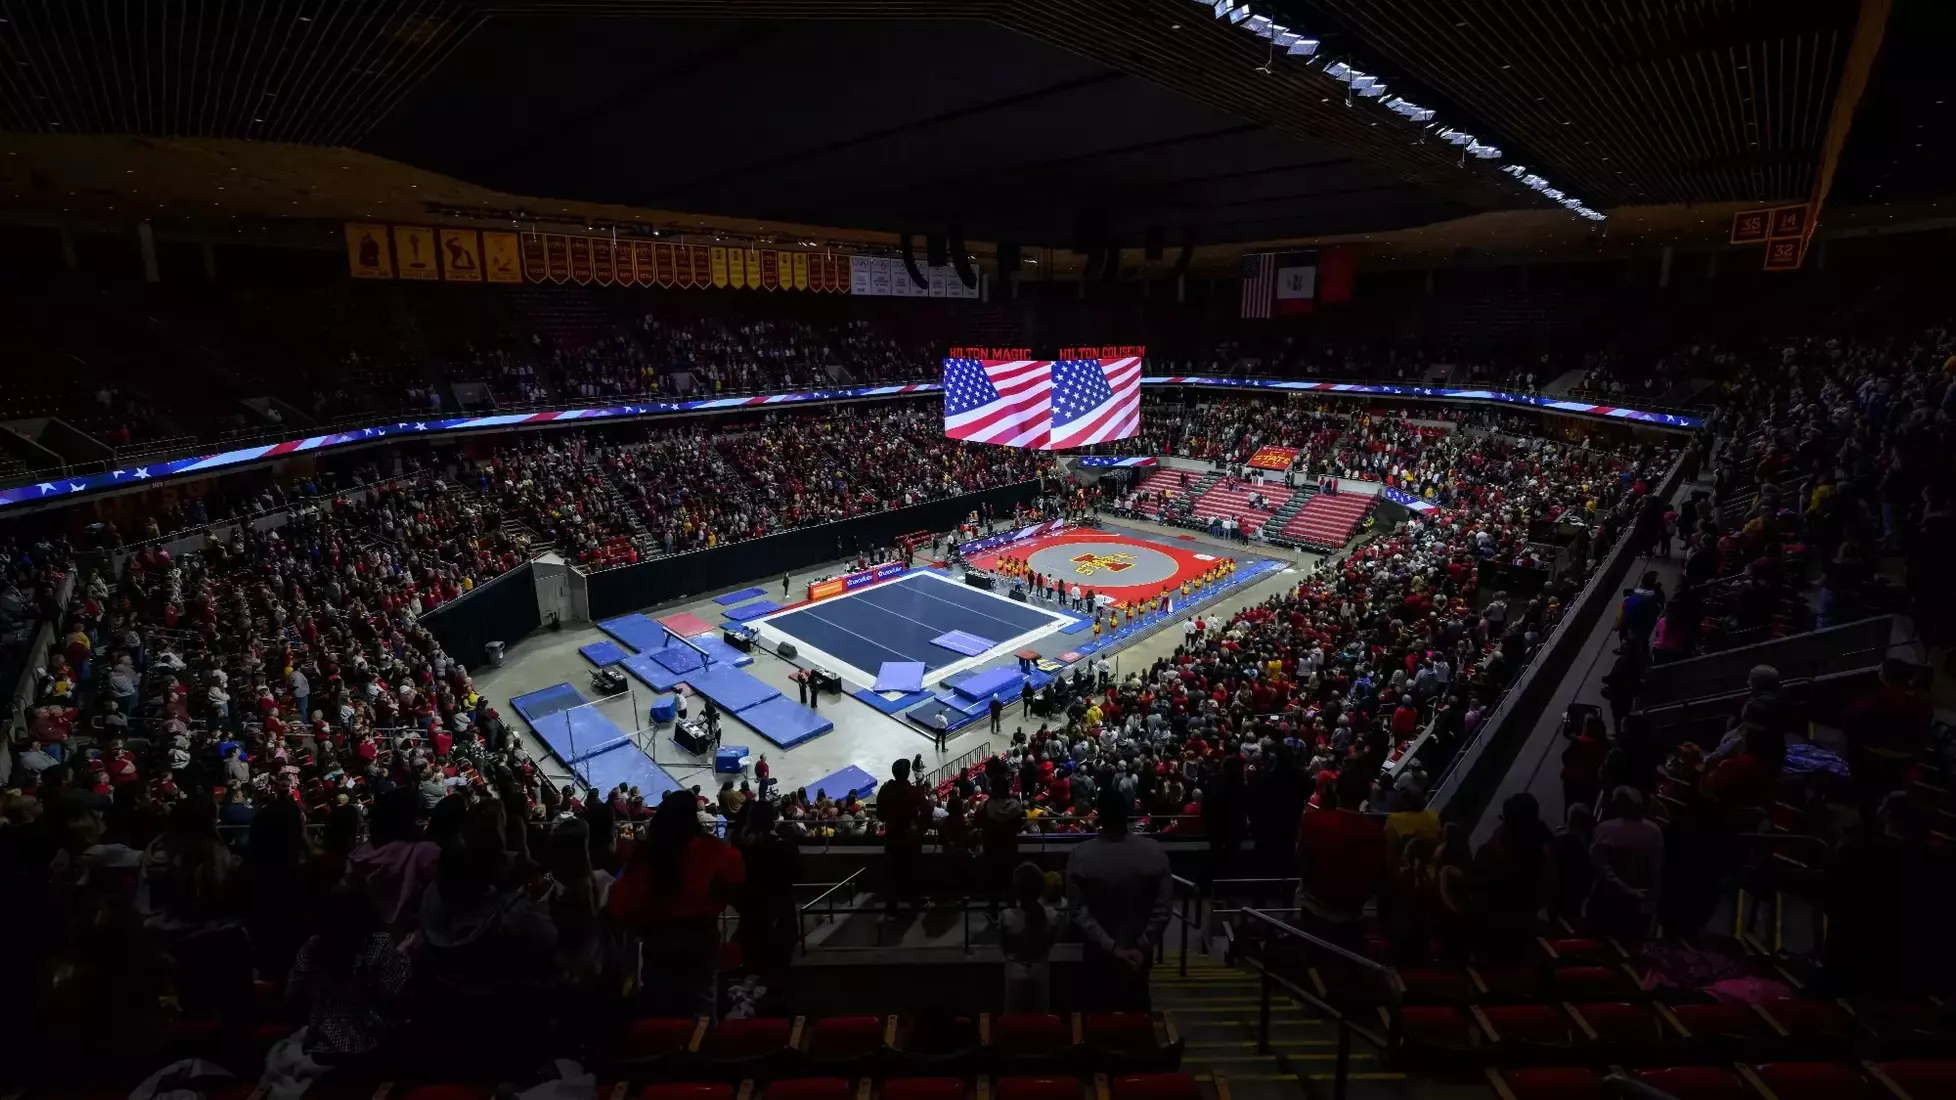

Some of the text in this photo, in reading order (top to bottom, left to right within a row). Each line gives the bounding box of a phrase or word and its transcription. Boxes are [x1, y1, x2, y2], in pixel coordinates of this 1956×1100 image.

[1742, 217, 1761, 231] 35
[1779, 212, 1797, 227] 14
[1773, 243, 1795, 258] 32
[950, 347, 1031, 360] HILTON MAGIC
[1059, 346, 1146, 360] HILTON COLISEUM
[1253, 455, 1291, 465] STATE
